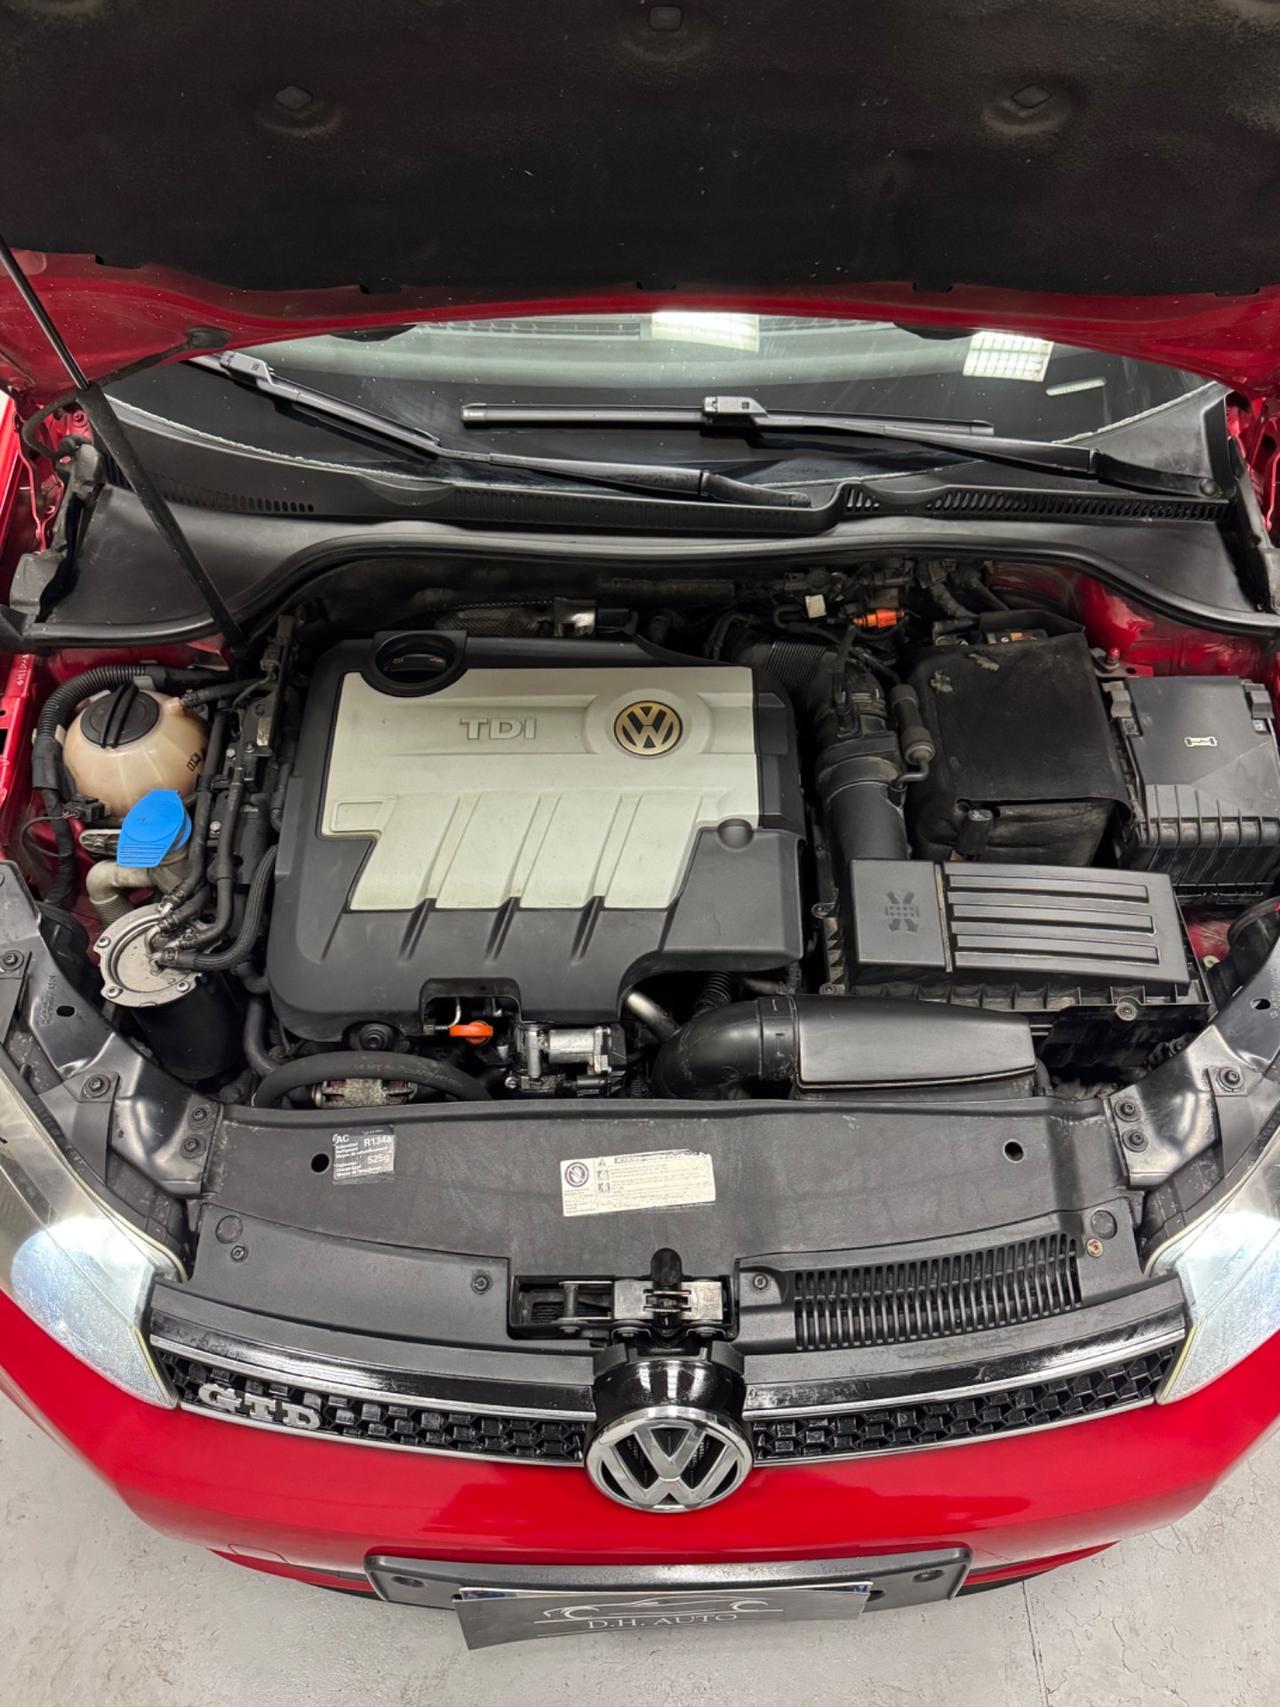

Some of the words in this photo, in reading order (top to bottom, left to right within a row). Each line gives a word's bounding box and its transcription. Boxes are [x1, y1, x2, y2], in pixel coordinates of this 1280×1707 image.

[459, 717, 537, 740] TDI
[615, 701, 682, 755] VW
[336, 1134, 350, 1143] AC
[363, 1136, 392, 1147] R134a
[198, 1382, 321, 1430] GTD
[590, 1410, 750, 1512] VW
[588, 1618, 645, 1629] D.H.
[653, 1613, 738, 1626] AUTO
